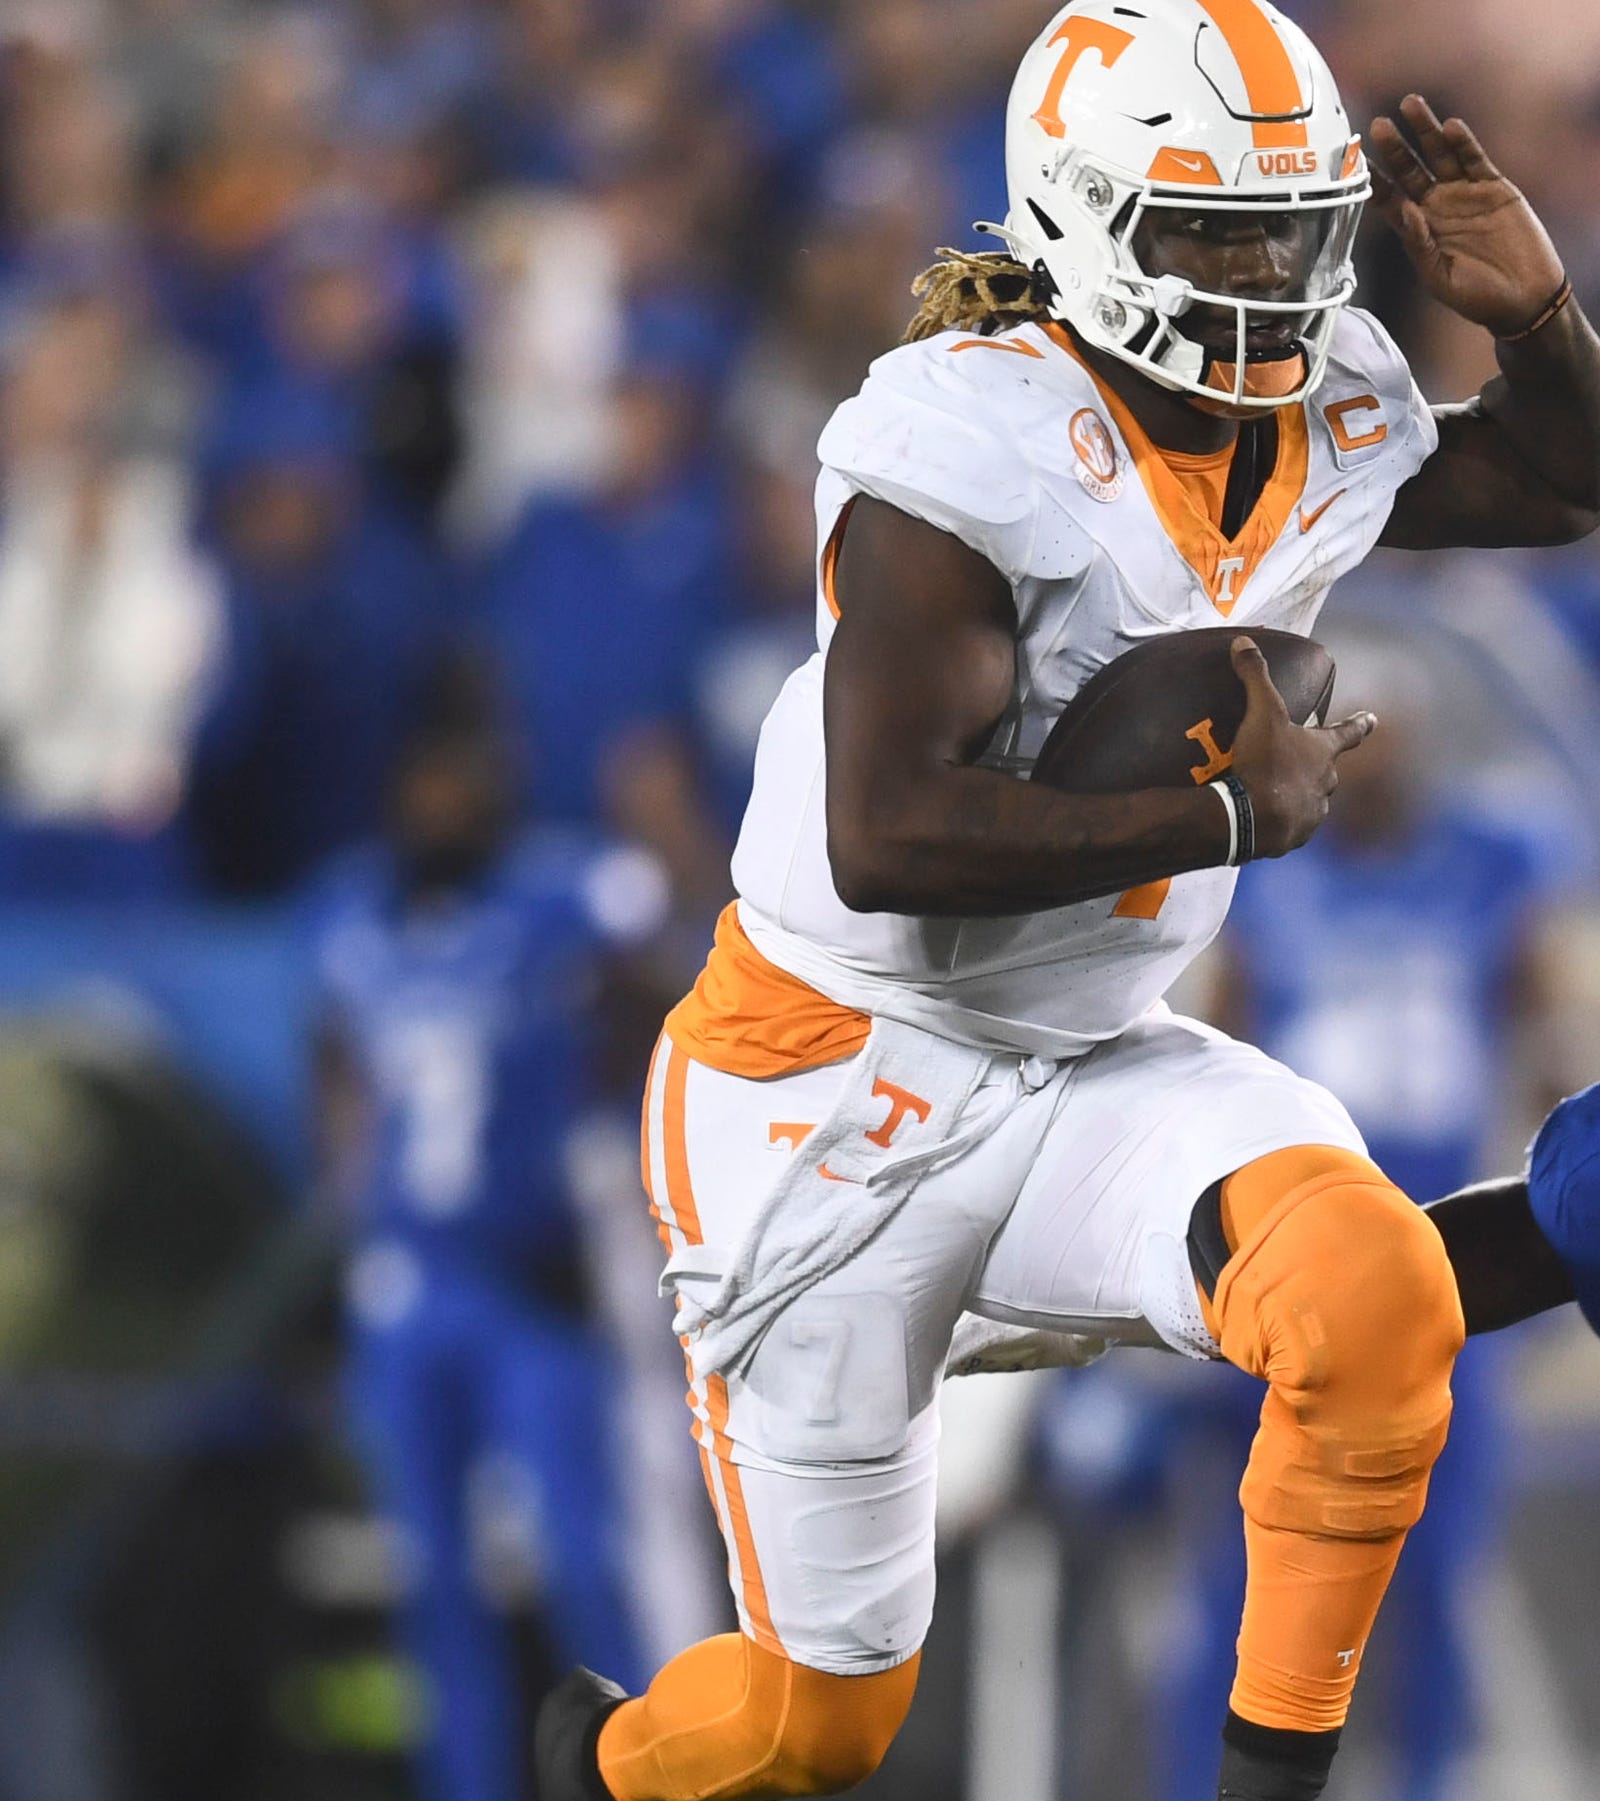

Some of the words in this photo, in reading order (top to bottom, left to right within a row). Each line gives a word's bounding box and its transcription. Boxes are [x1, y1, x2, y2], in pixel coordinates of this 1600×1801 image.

[1030, 15, 1135, 137] T
[1257, 151, 1318, 177] VOLS
[1323, 394, 1388, 452] C
[1216, 557, 1244, 602] T
[864, 1077, 932, 1148] T
[1337, 1649, 1355, 1667] T
